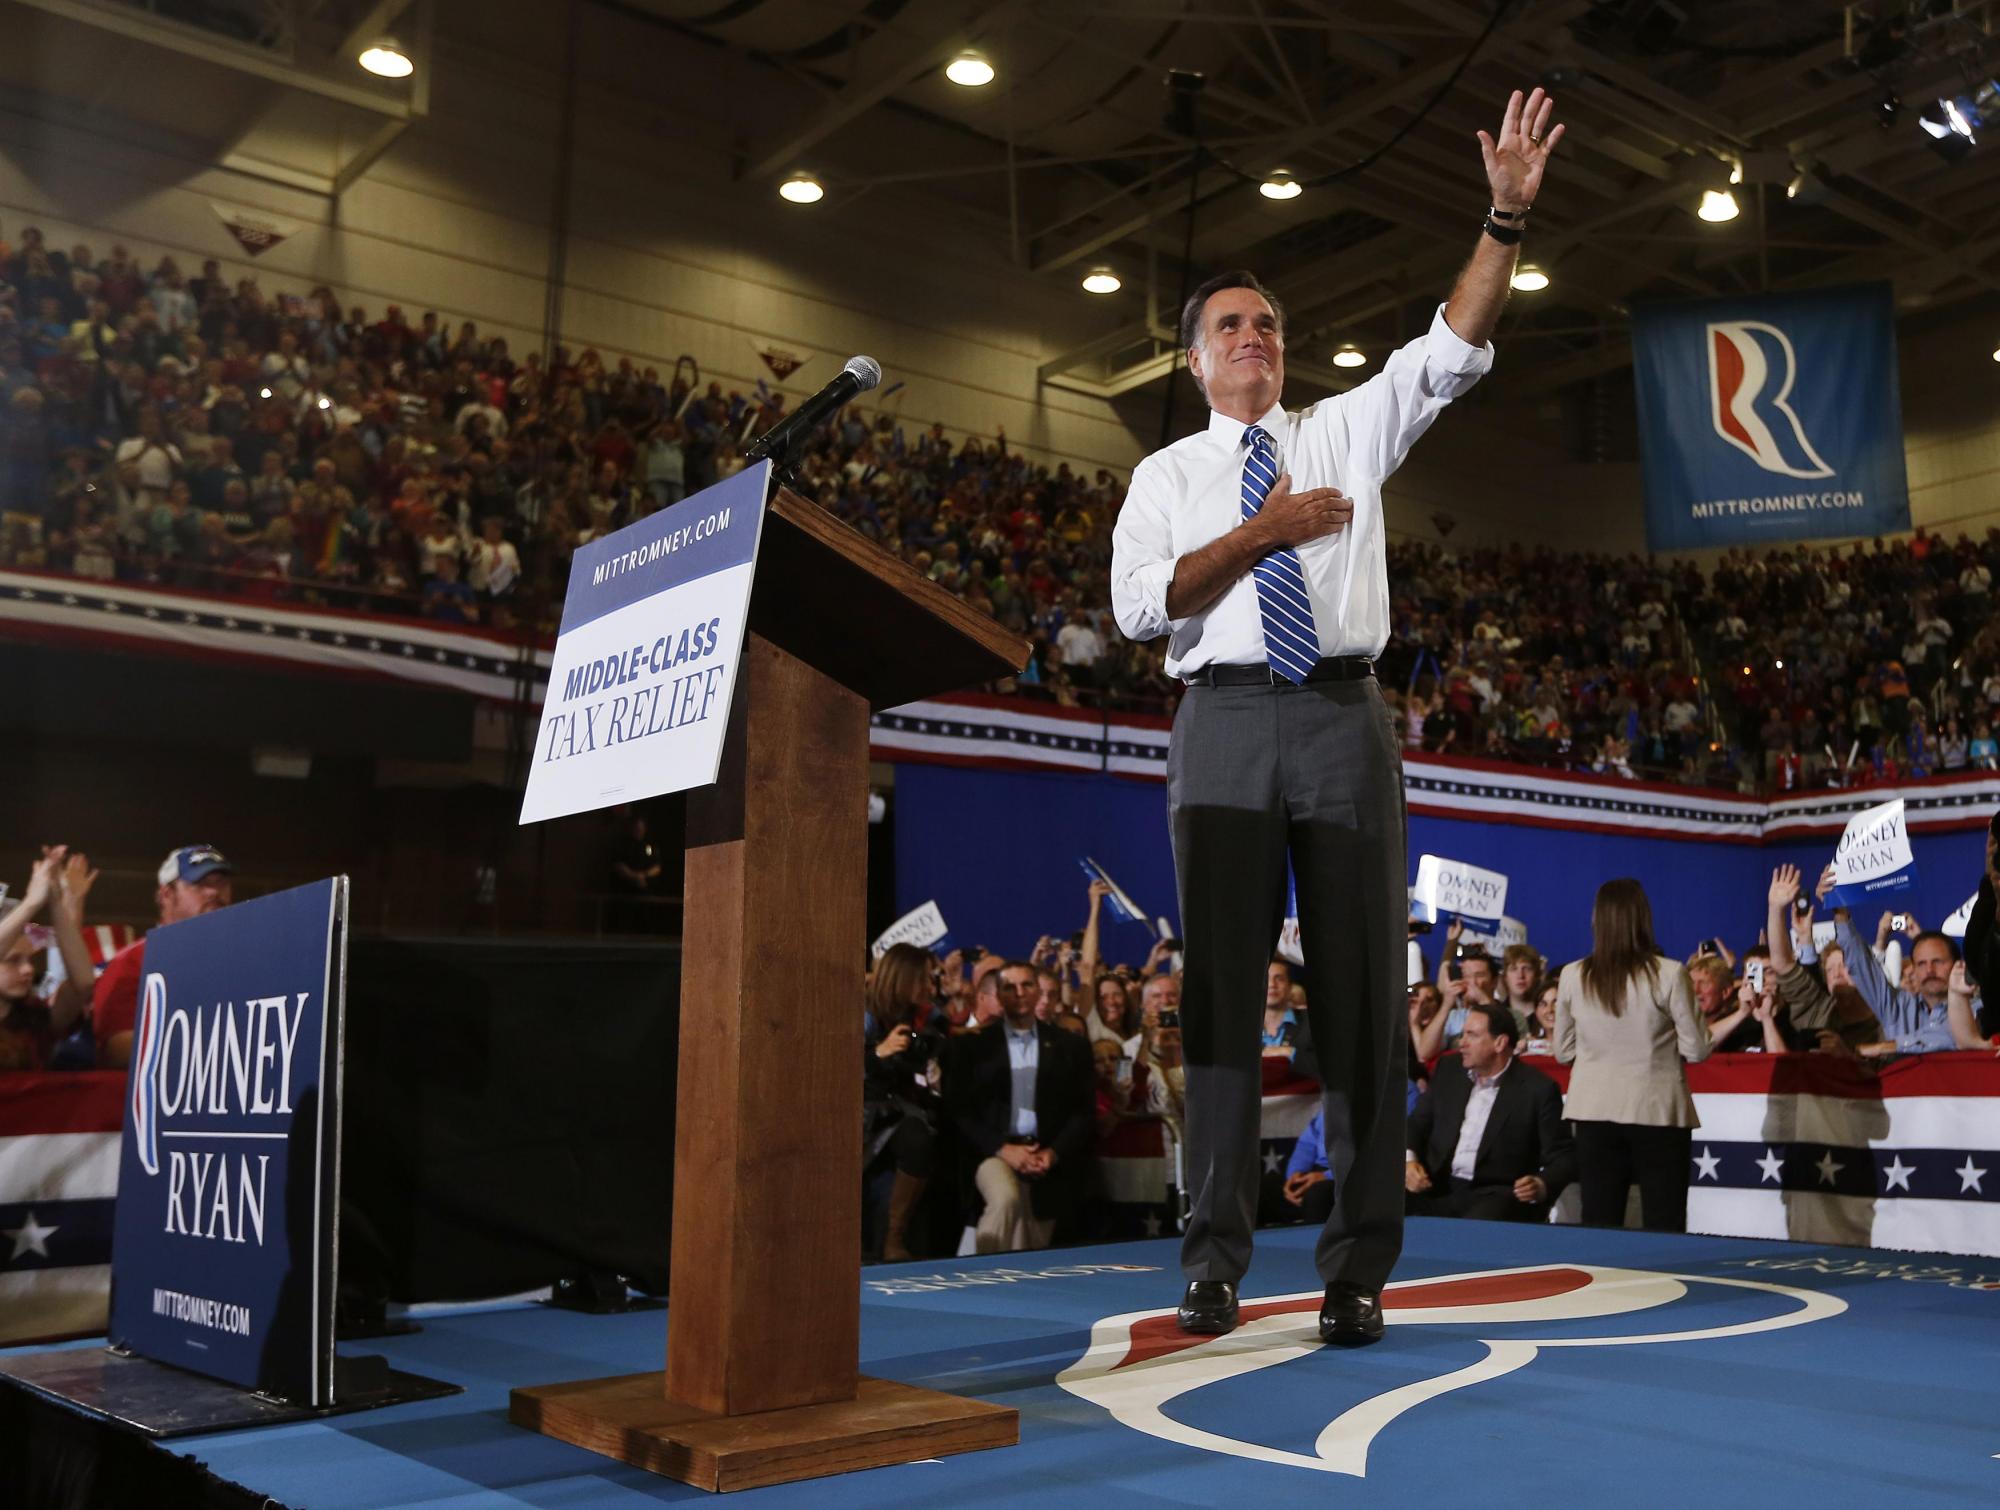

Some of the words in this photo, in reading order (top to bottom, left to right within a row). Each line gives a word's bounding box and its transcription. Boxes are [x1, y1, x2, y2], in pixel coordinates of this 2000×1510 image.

[1691, 491, 1864, 519] MITTROMNEY.COM
[593, 508, 731, 585] MITTROMNEY.COM
[562, 617, 720, 702] MIDDLE-CLASS
[543, 703, 604, 763] TAX
[604, 665, 723, 746] RELIEF
[1437, 871, 1502, 900] OMNEY
[1846, 847, 1894, 874] RYAN
[1443, 891, 1489, 912] RYAN
[132, 972, 310, 1175] ROMNEY
[164, 1151, 271, 1247] RYAN
[152, 1287, 251, 1337] MITTROMNEY.COM
